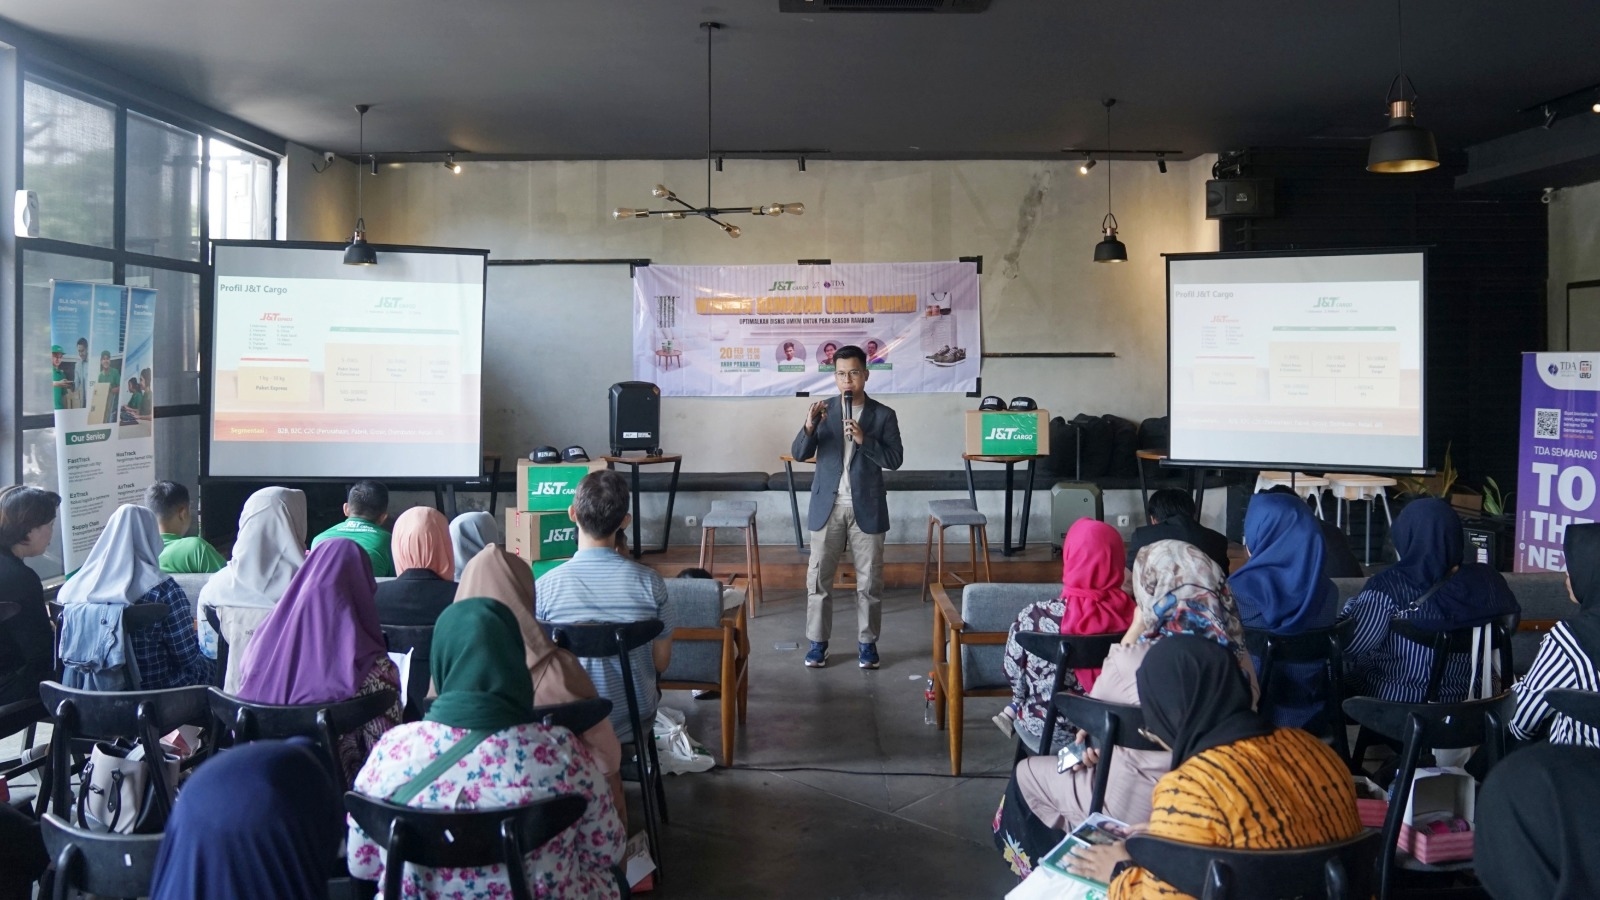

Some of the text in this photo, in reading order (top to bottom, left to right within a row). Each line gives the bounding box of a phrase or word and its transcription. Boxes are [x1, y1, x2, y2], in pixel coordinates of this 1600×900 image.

[769, 281, 795, 291] J&T
[831, 279, 845, 287] TDA
[220, 284, 288, 295] Profil J&T Cargo
[1175, 290, 1234, 299] Profil J&T Cargo
[260, 312, 281, 321] J&T
[720, 347, 733, 360] 20
[1560, 361, 1577, 370] TDA
[70, 431, 106, 443] Our Service
[985, 427, 1019, 440] J&T
[1533, 446, 1598, 460] TDA SEMARANG
[67, 456, 90, 464] FastTrack
[531, 481, 568, 495] J&T
[1531, 461, 1597, 512] TO
[71, 523, 89, 531] Supply
[1530, 510, 1595, 545] TH
[543, 527, 576, 544] J&T
